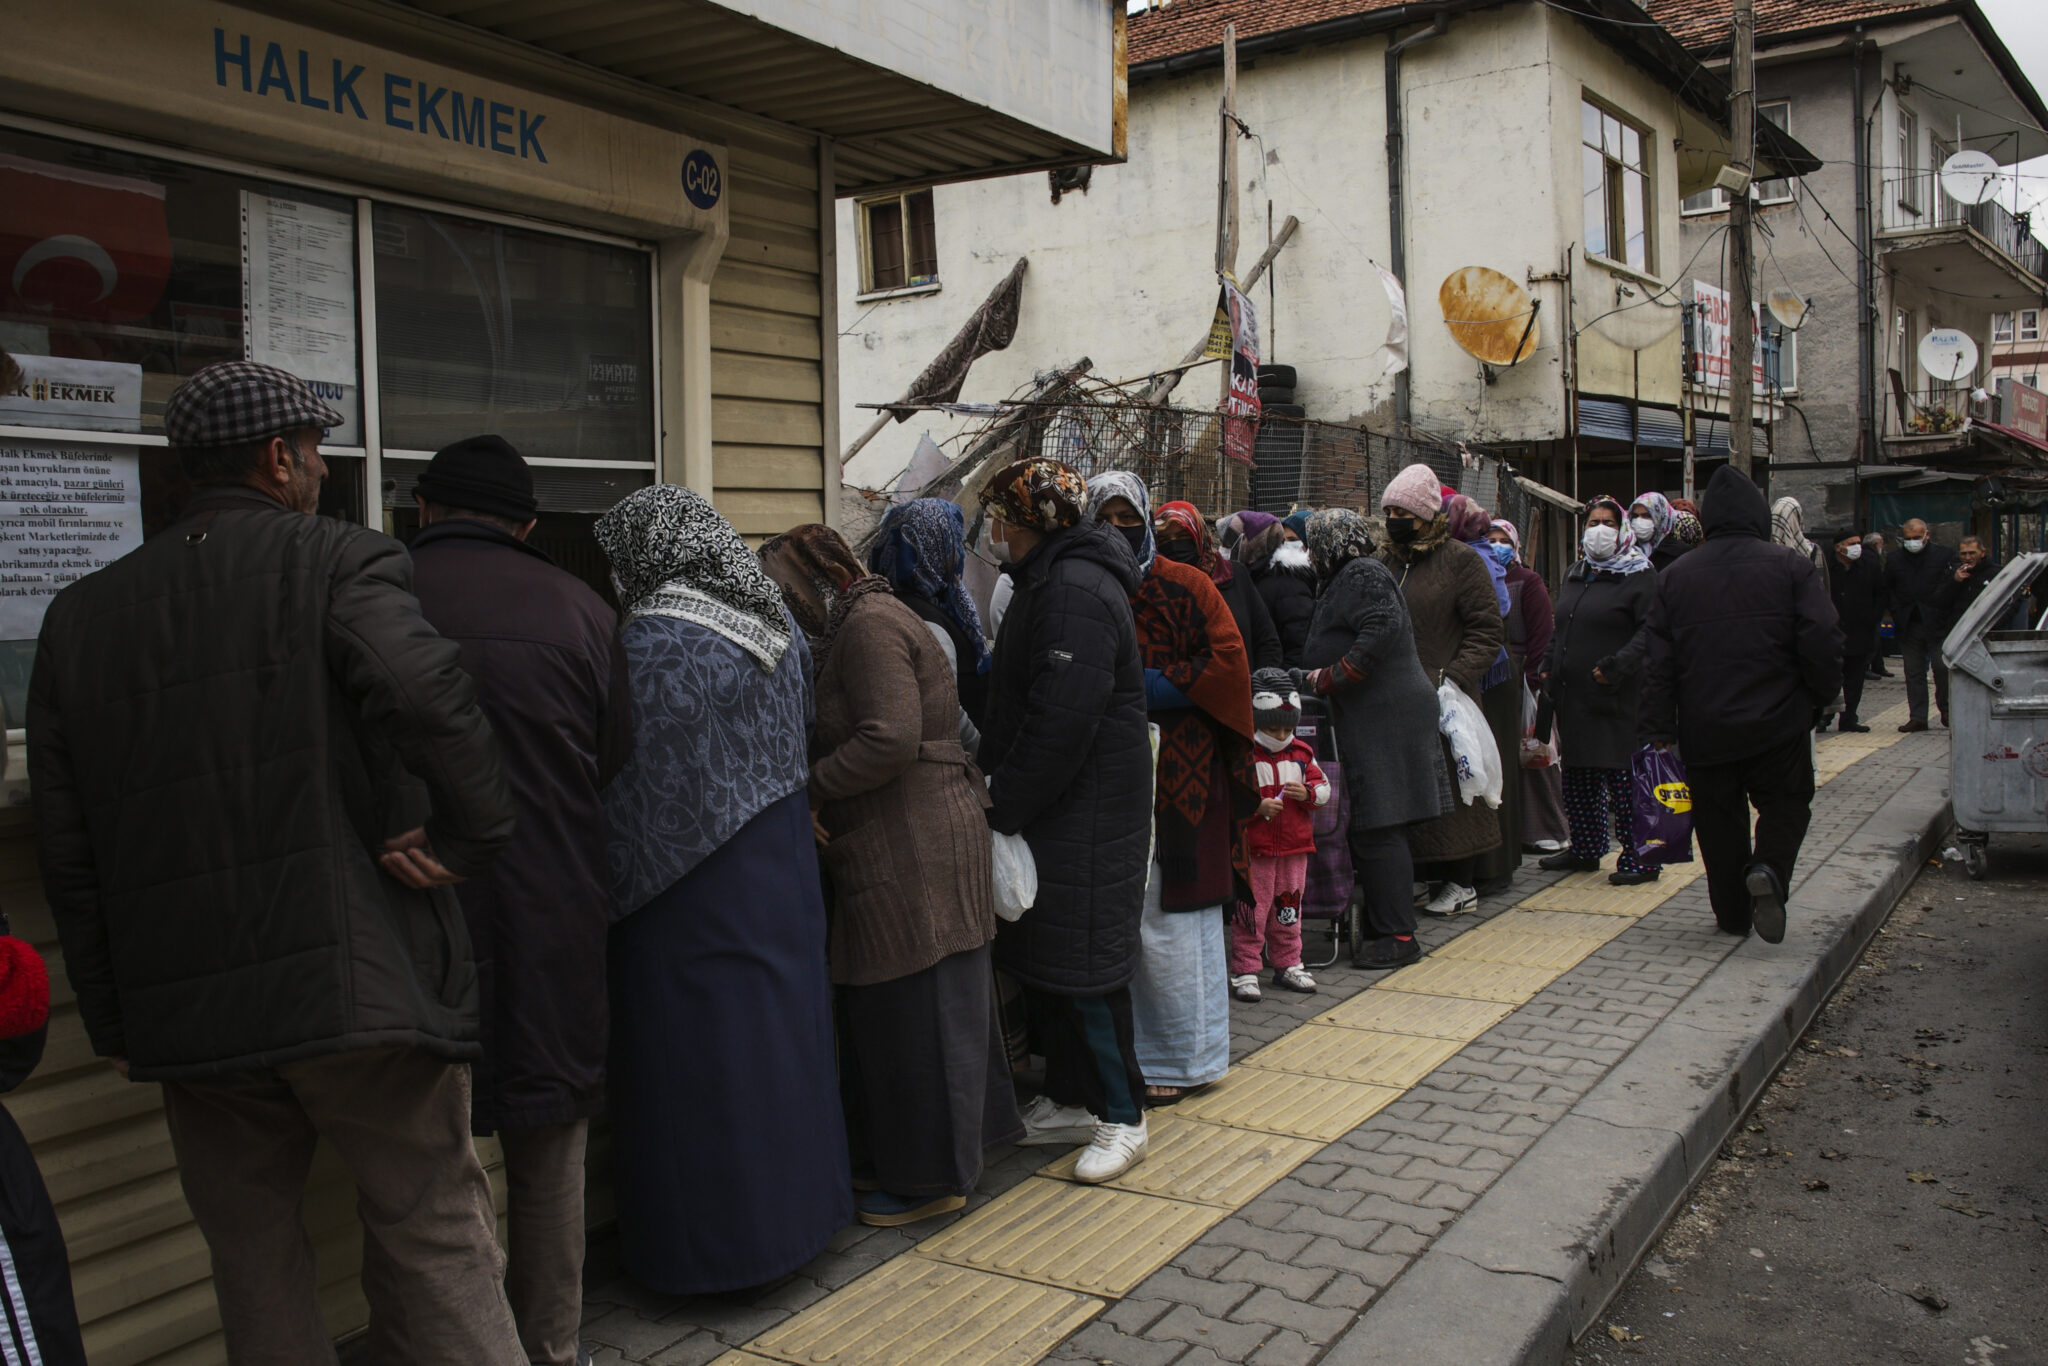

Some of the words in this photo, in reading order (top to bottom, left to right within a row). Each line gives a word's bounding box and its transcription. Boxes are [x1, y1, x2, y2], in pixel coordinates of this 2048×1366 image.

[214, 28, 369, 121] HALK
[384, 72, 548, 164] EKMEK
[686, 160, 718, 197] C-02
[51, 386, 115, 403] EKMEK
[23, 449, 58, 460] Ekmek
[61, 450, 113, 462] Büfelerinde
[23, 464, 81, 475] kuyrukların
[83, 464, 111, 475] önüne
[15, 478, 61, 489] amacıyla,
[64, 480, 89, 490] pazar
[93, 480, 124, 490] günleri
[10, 491, 59, 502] üreteceğiz
[62, 493, 72, 501] ve
[75, 491, 125, 502] büfelerimiz
[20, 504, 40, 515] açık
[43, 505, 88, 515] olacaktır.
[28, 518, 56, 528] mobil
[58, 518, 111, 529] fırınlarımız
[28, 531, 107, 541] Marketlerimizde
[109, 532, 120, 541] de
[18, 546, 40, 557] satış
[43, 546, 92, 557] yapacağız.
[62, 560, 92, 569] ekmek
[1, 573, 43, 583] haftanın
[45, 573, 50, 582] 7
[53, 573, 77, 584] günü
